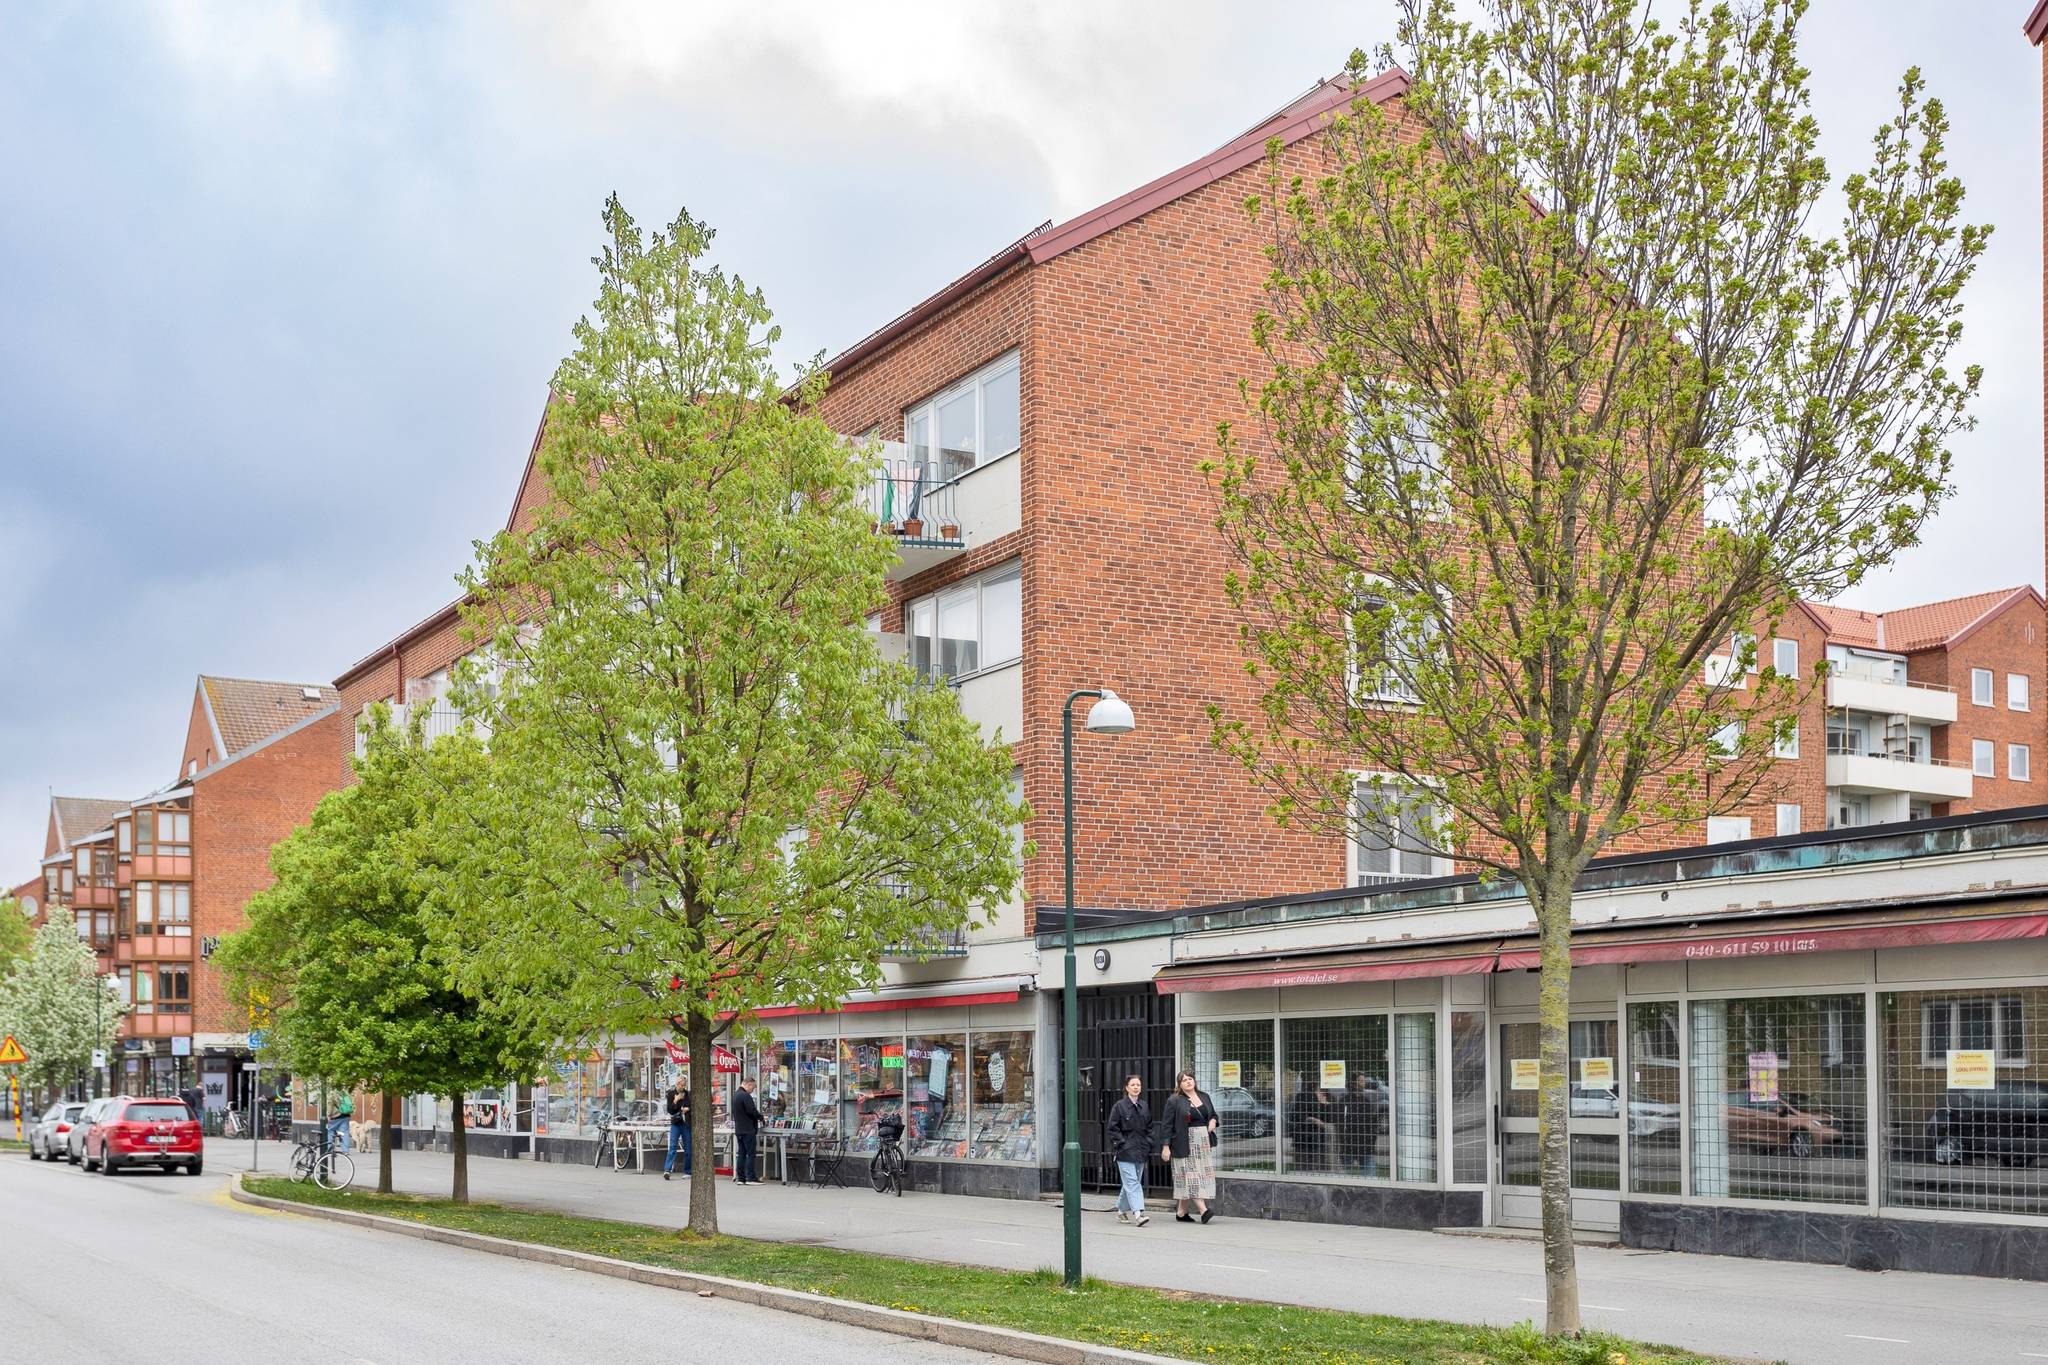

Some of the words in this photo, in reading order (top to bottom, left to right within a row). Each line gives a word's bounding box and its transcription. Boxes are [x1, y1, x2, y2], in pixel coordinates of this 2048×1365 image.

[1686, 942, 1747, 957] 040-611
[1751, 941, 1770, 954] 59
[1774, 939, 1789, 952] 10
[671, 1047, 691, 1060] Öpp
